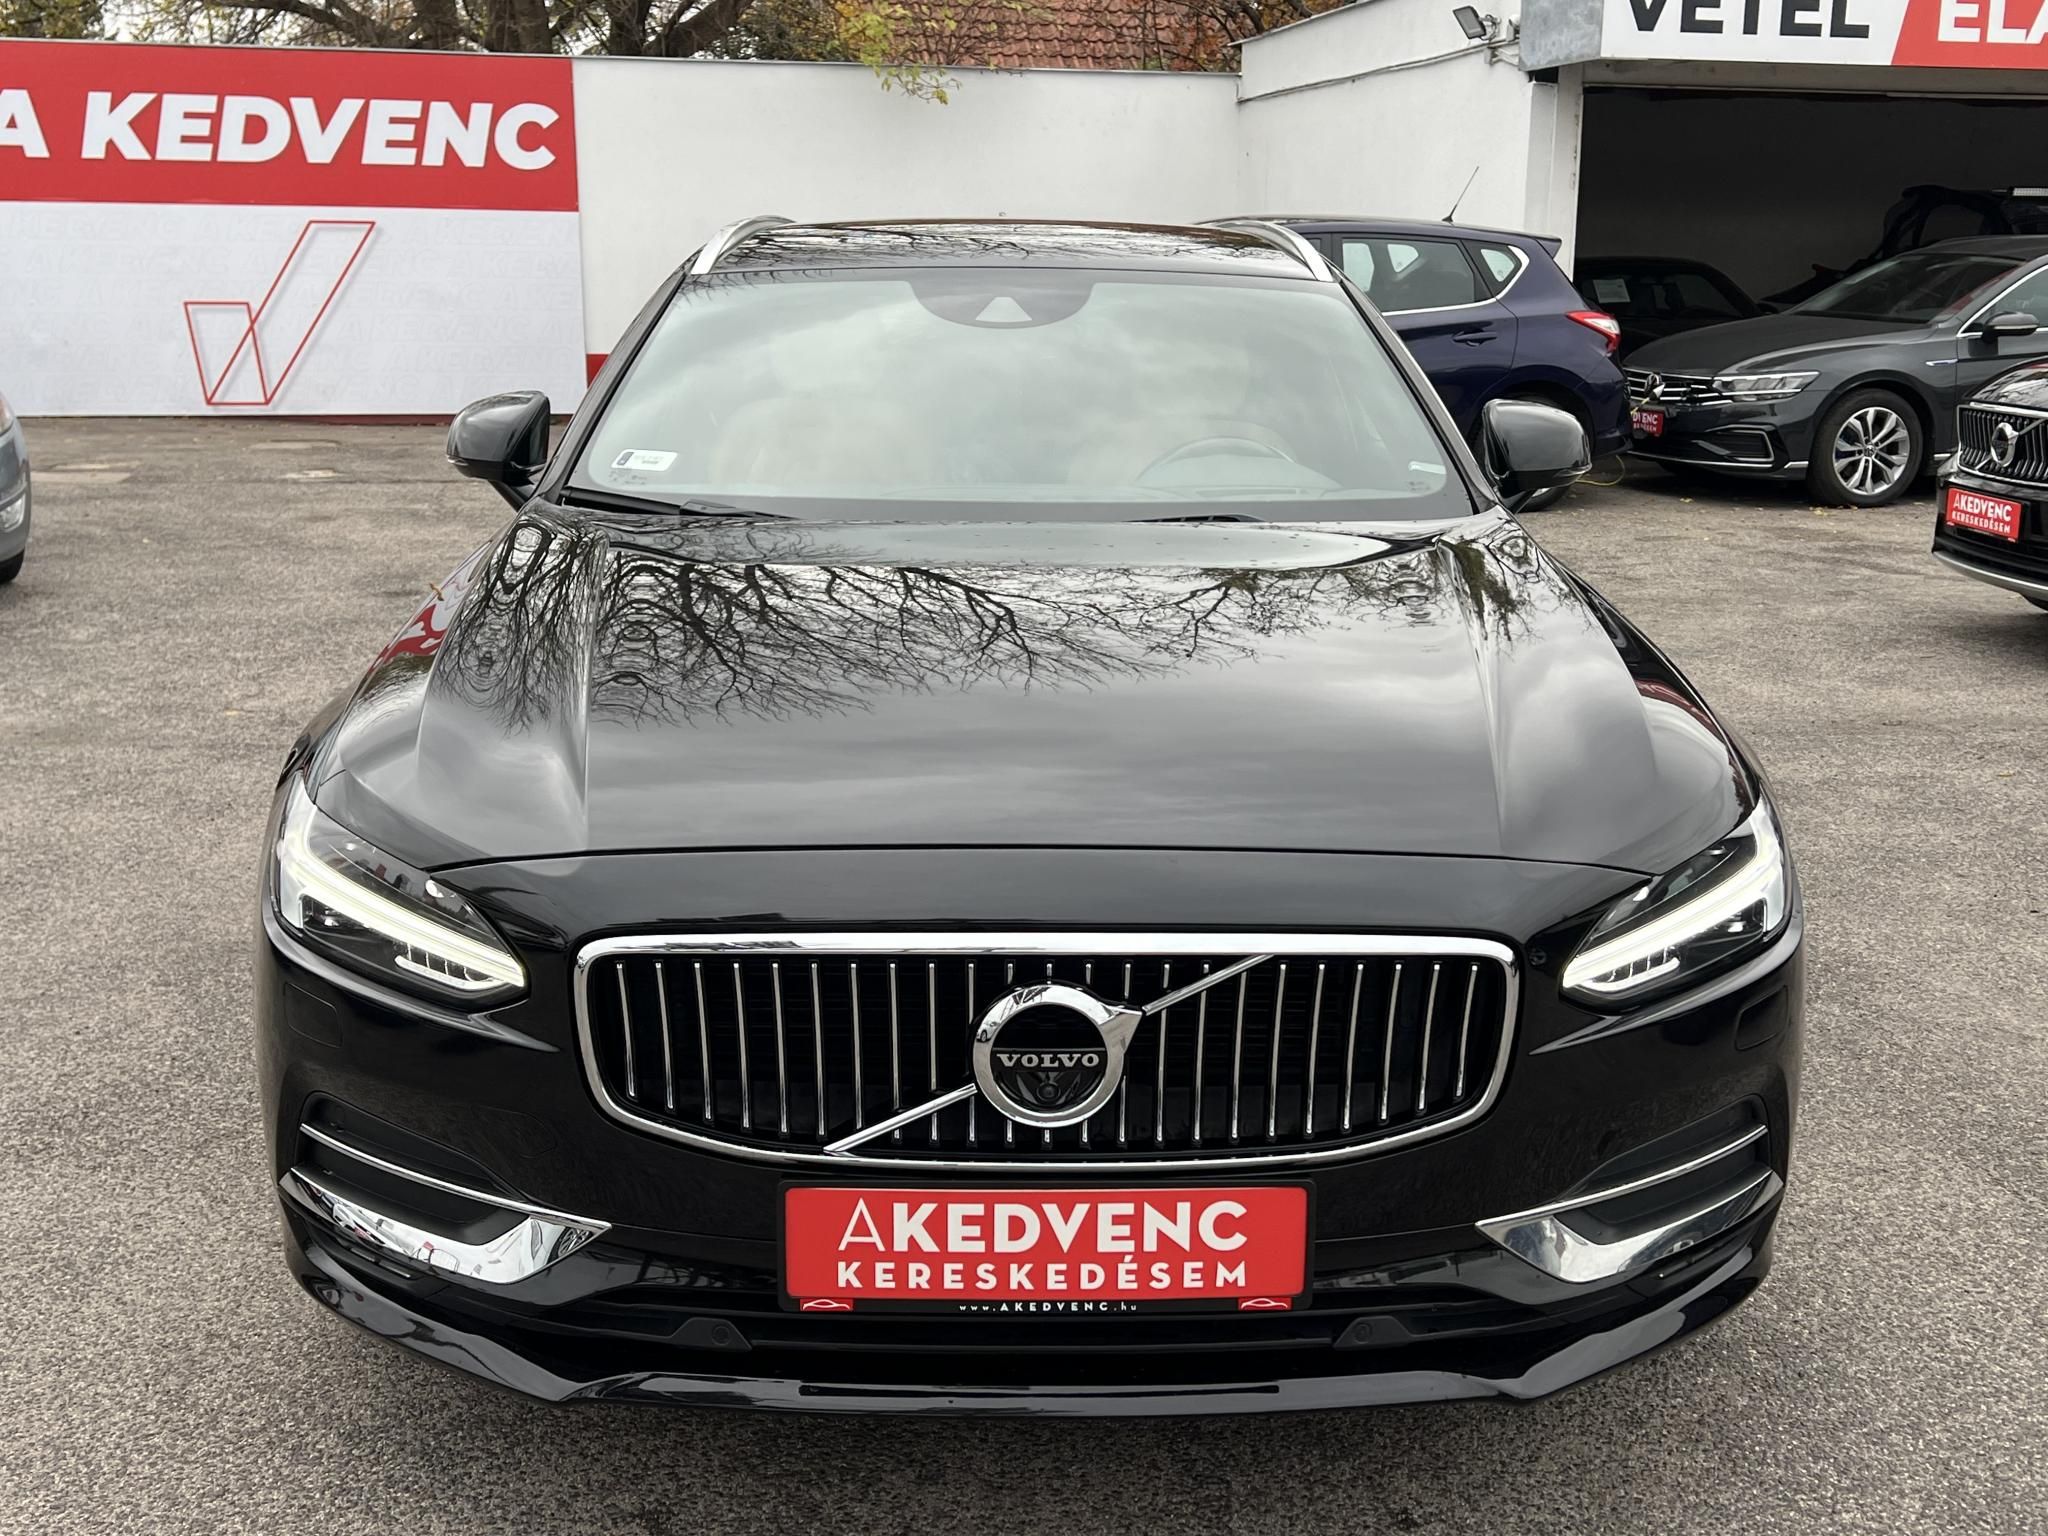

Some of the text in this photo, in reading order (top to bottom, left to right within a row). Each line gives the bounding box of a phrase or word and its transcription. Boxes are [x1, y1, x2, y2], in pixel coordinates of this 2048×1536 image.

[0, 88, 560, 170] A KEDVENC
[996, 1053, 1100, 1068] VOLVO
[837, 1197, 1249, 1254] AKEDVENC
[836, 1255, 1248, 1290] KERESKEDÉSEM
[959, 1301, 1137, 1312] www.AKEDVENC.hu
